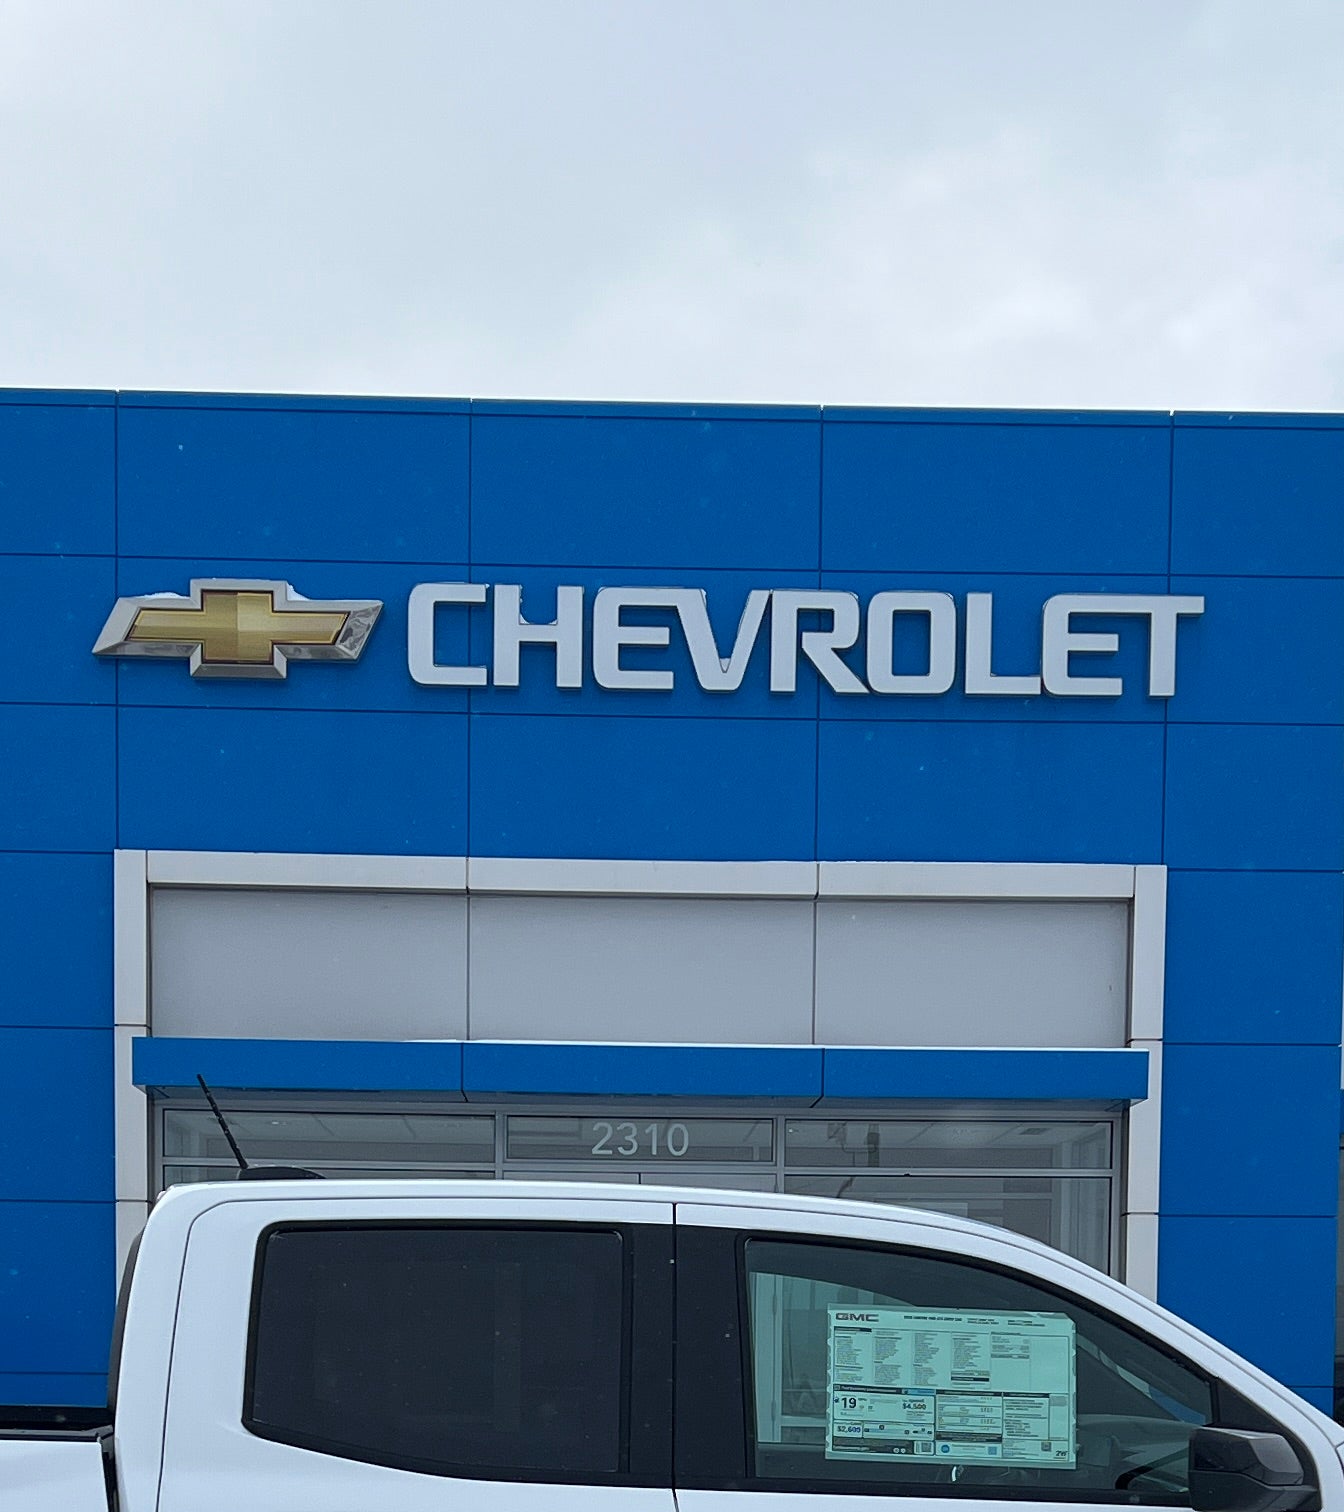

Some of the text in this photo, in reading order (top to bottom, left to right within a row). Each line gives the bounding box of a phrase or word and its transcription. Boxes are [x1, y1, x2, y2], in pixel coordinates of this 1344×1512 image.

[407, 582, 1206, 698] CHEVROLET
[591, 1122, 689, 1157] 2310
[835, 1312, 880, 1323] GMC
[841, 1397, 857, 1409] 19
